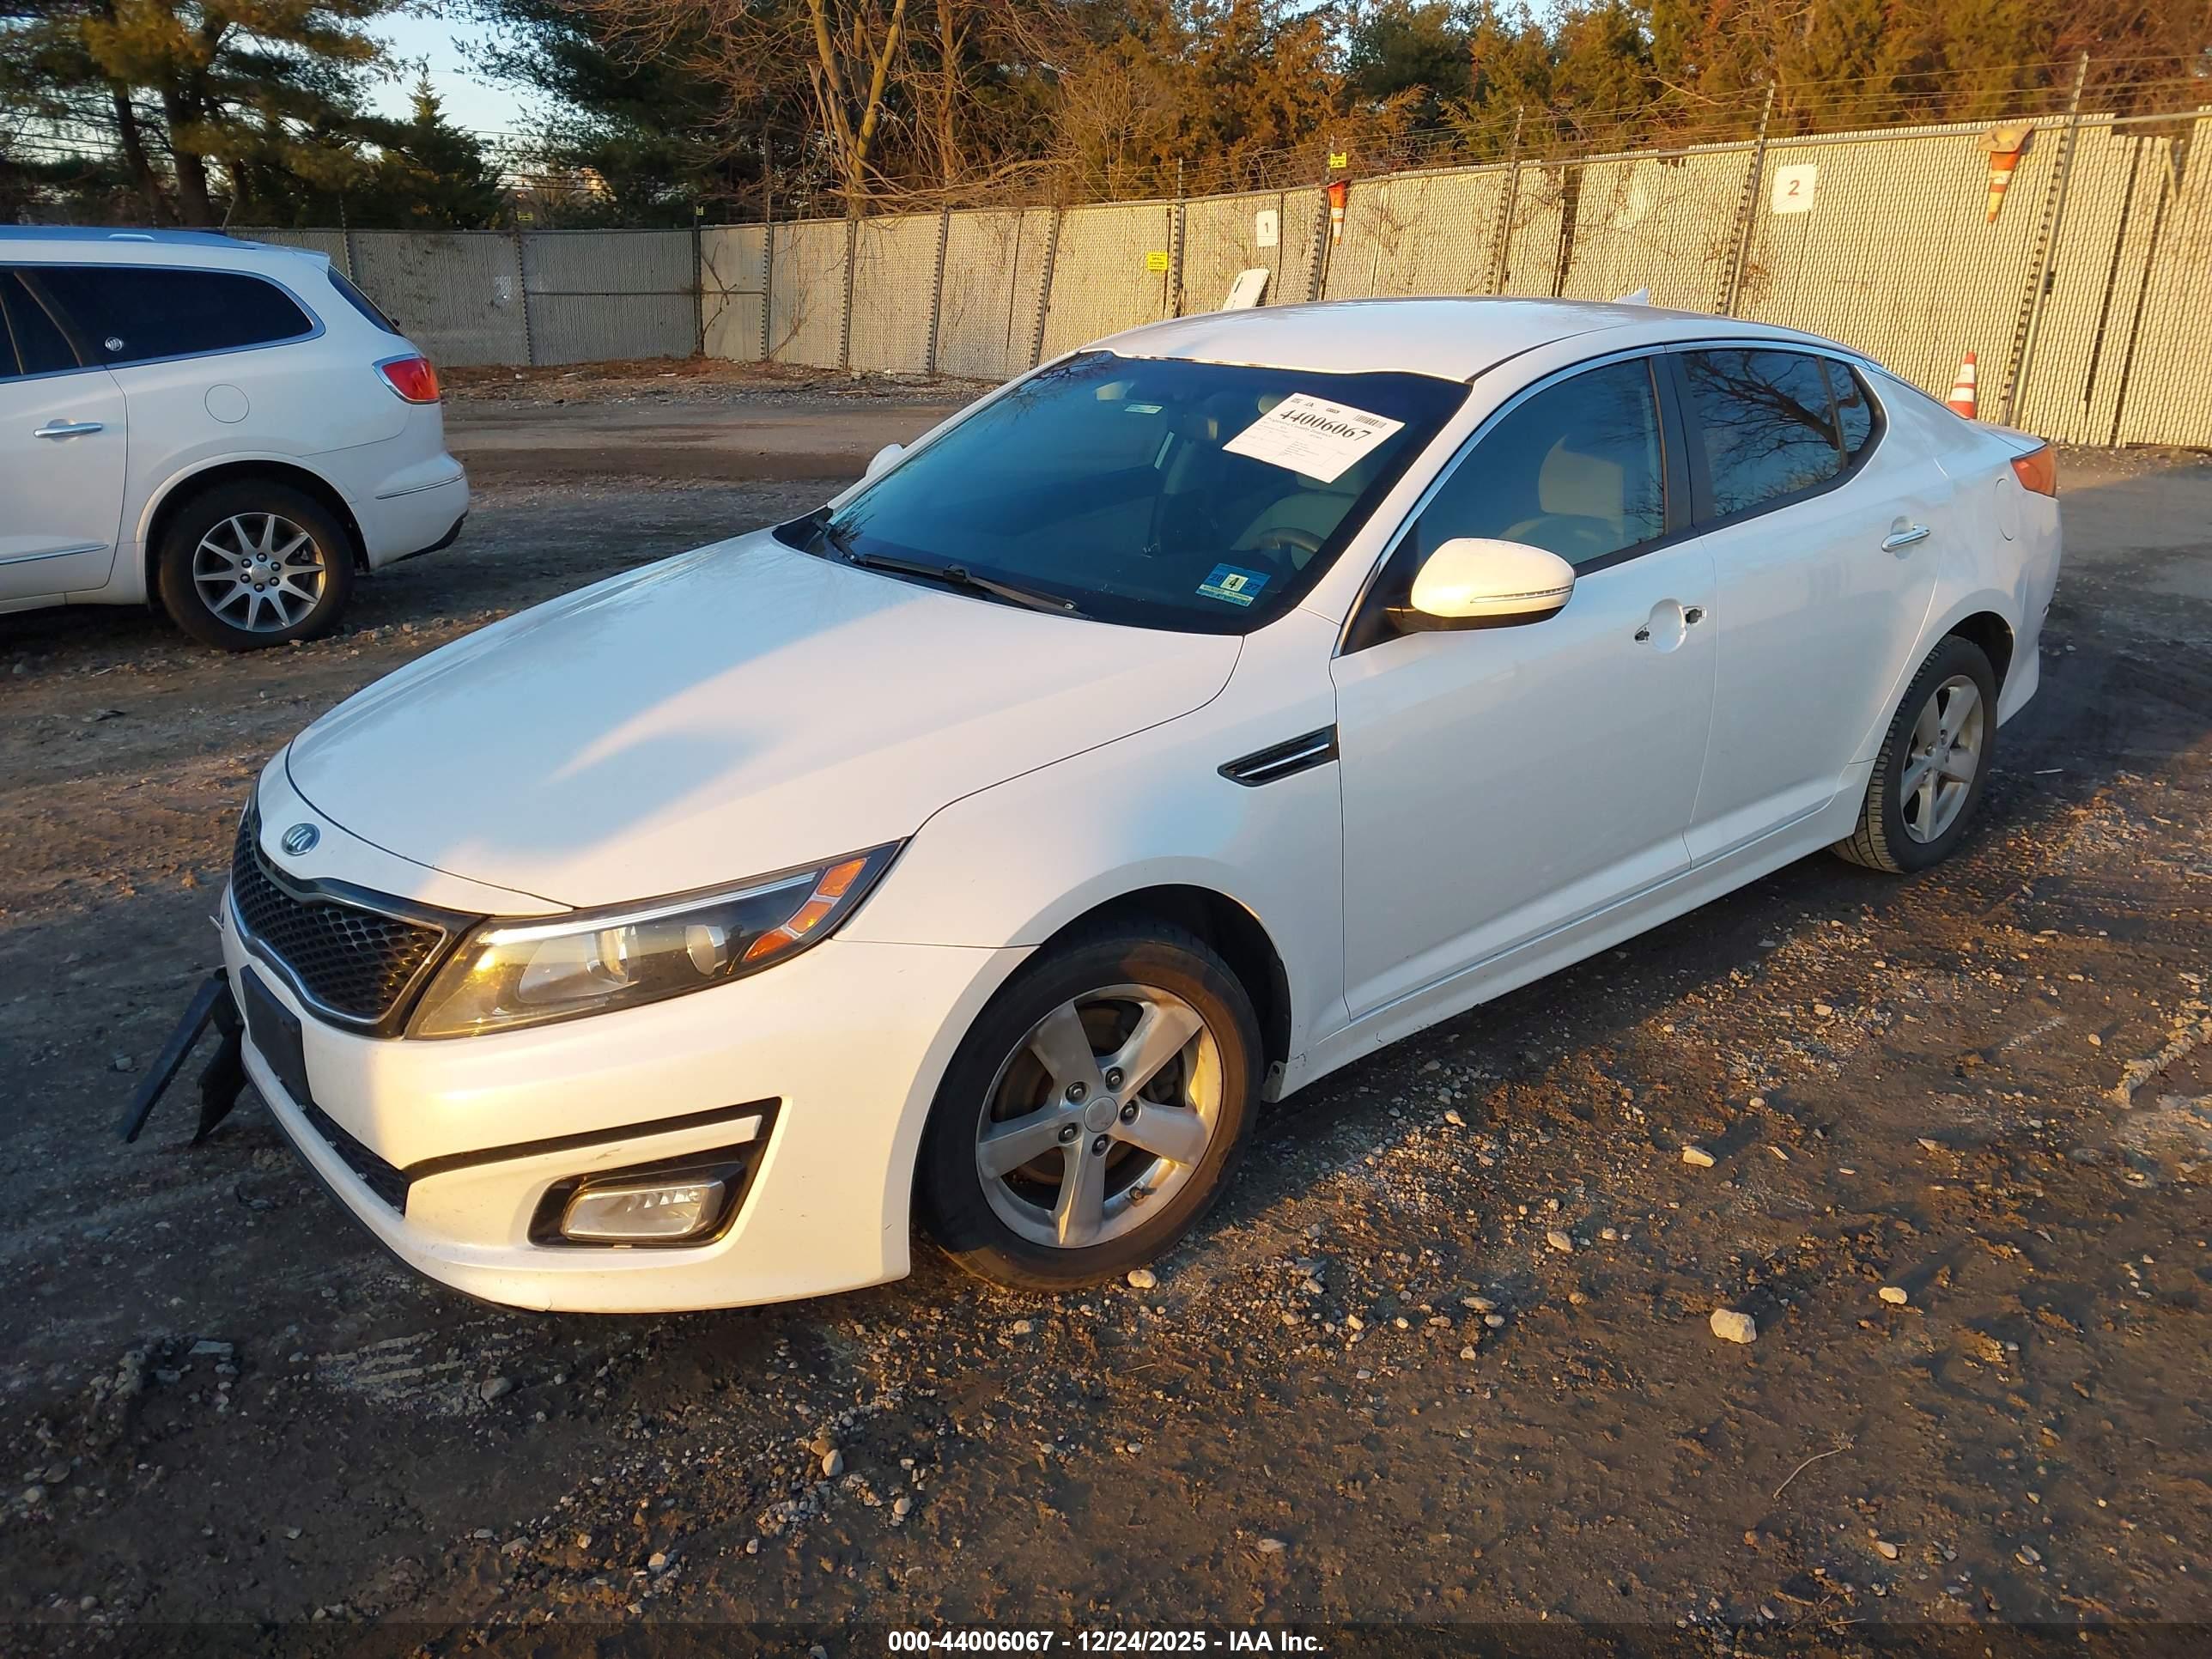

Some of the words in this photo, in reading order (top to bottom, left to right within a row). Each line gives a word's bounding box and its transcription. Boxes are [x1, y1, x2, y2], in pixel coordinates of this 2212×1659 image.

[1788, 179, 1801, 196] 2
[1264, 222, 1269, 234] 1
[1279, 409, 1373, 442] 44006067
[1228, 577, 1240, 589] 4
[1244, 582, 1261, 592] 27
